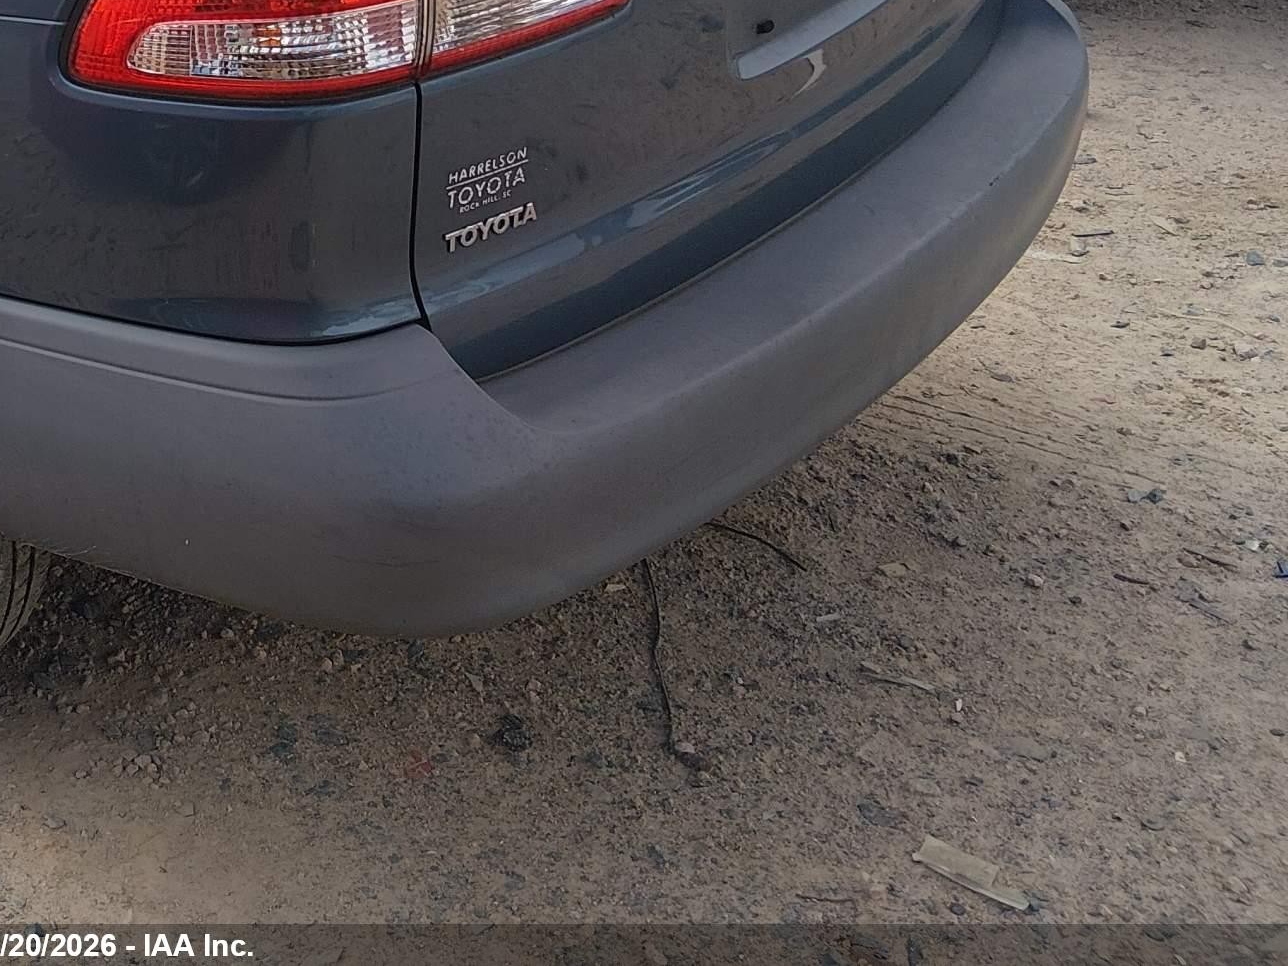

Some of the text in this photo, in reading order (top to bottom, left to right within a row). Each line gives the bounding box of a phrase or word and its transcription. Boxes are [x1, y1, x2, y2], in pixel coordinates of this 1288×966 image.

[448, 146, 528, 184] HARRELSON
[447, 167, 526, 208] TOYOTA
[459, 202, 480, 214] ROCK
[502, 189, 512, 199] SC
[444, 202, 538, 253] TOYOTA
